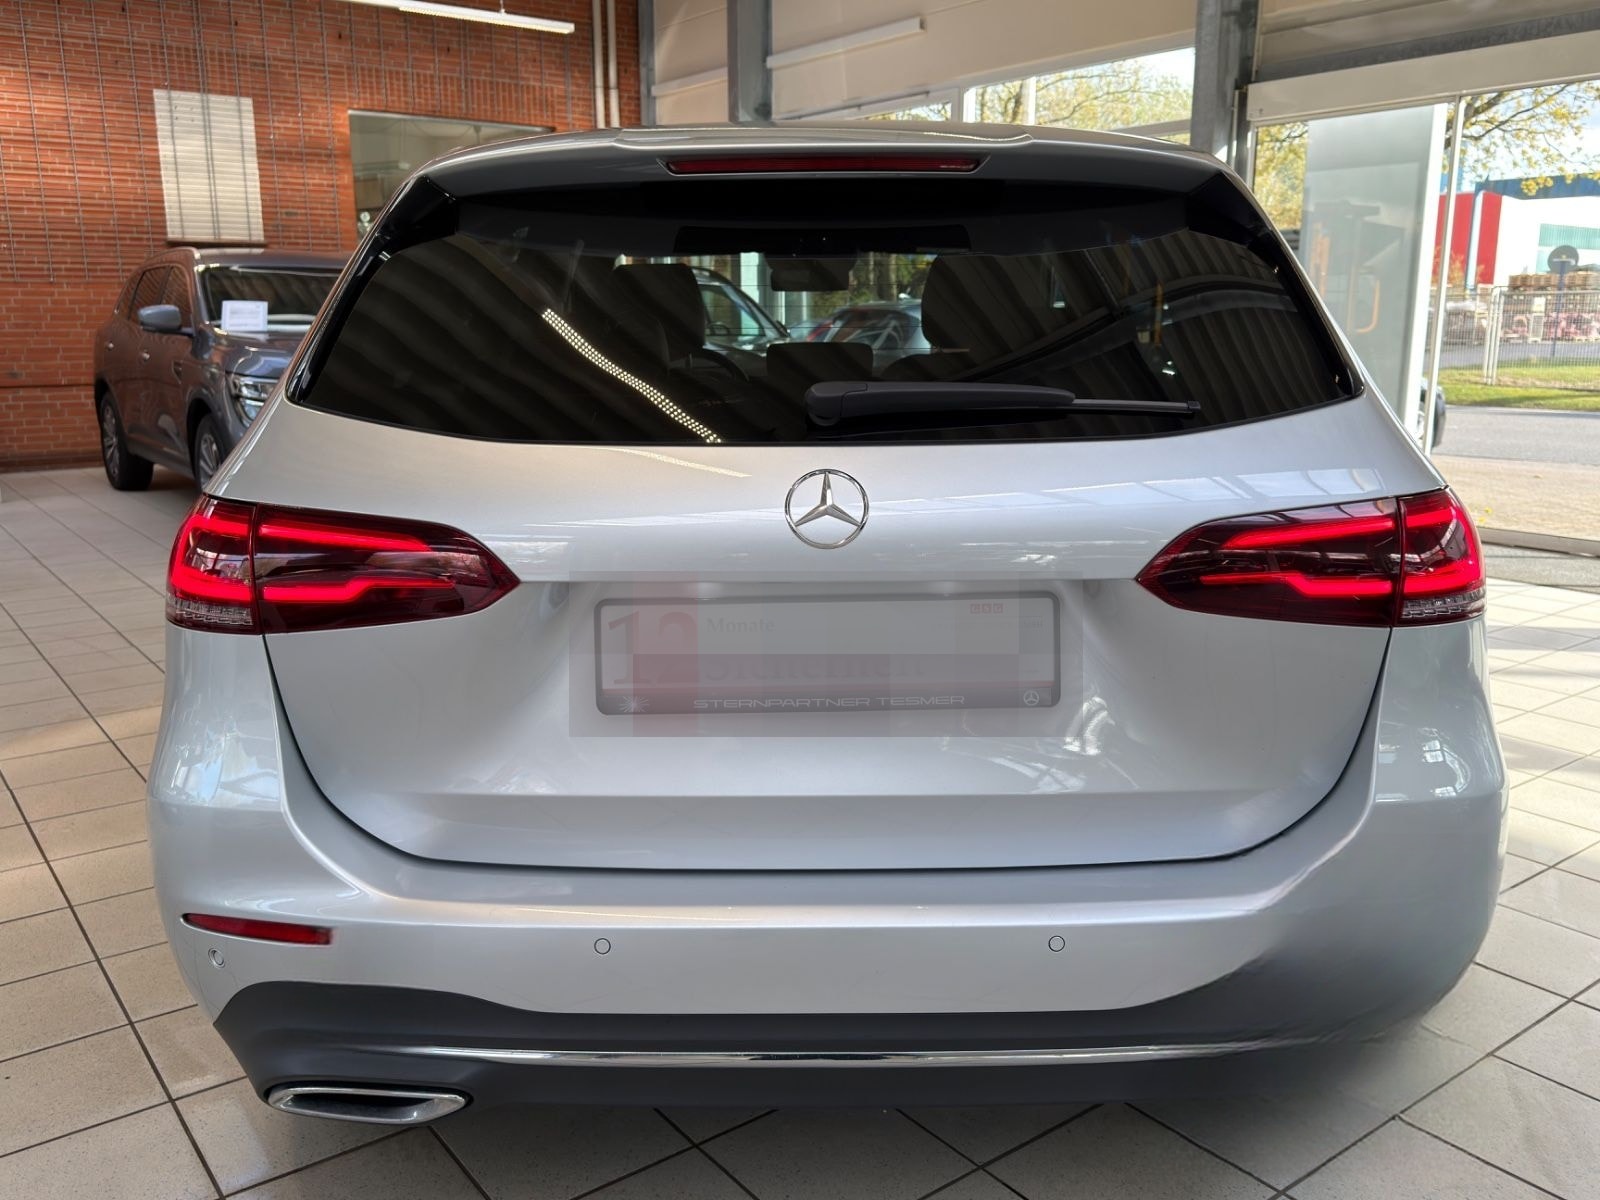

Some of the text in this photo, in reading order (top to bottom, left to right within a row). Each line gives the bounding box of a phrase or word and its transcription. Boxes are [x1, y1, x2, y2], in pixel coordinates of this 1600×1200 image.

[706, 617, 775, 633] Monate
[608, 611, 698, 685] 12
[693, 695, 965, 709] STERNPARTNER TESMER
